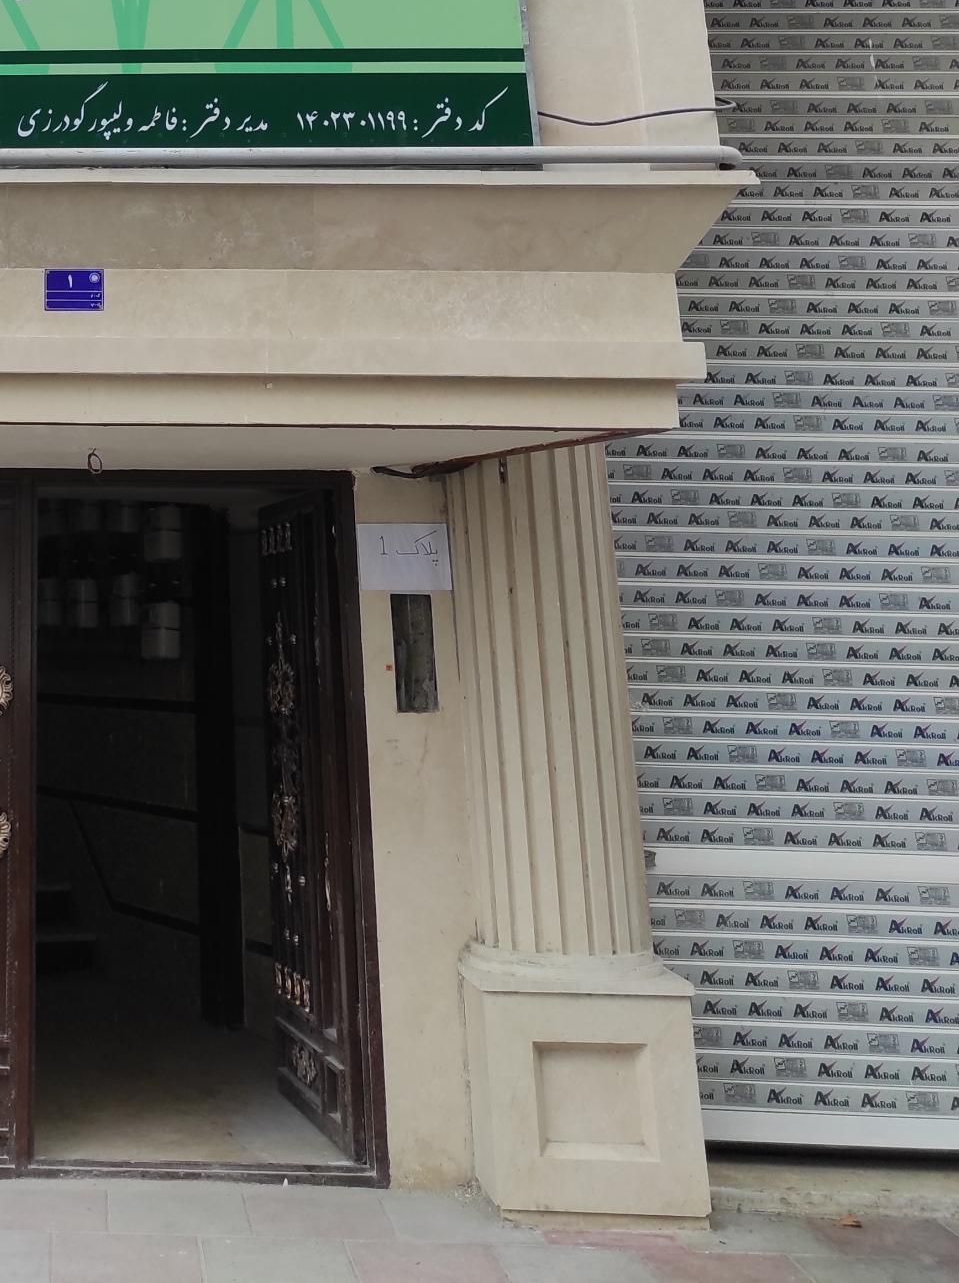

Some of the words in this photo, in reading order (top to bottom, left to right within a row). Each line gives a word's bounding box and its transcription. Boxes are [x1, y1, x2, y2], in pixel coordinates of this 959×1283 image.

[16, 80, 109, 138] گودرزی
[137, 104, 178, 132] فاطمه
[467, 85, 509, 133] کد
[235, 114, 269, 134] مدیر
[718, 256, 750, 270] AkRoll
[758, 256, 790, 270] AkRoll
[798, 256, 830, 270] AkRoll
[876, 257, 908, 271] AkRoll
[916, 258, 948, 272] AkRoll
[716, 344, 748, 358] AkRoll
[756, 344, 788, 358] AkRoll
[834, 346, 866, 360] AkRoll
[874, 346, 906, 360] AkRoll
[916, 347, 948, 361] AkRoll
[636, 443, 666, 458] AkRoll
[678, 444, 707, 459] AkRoll
[755, 445, 786, 461] AkRoll
[796, 446, 828, 462] AkRoll
[838, 446, 869, 462] AkRoll
[916, 448, 948, 464] AkRoll
[395, 529, 439, 567] پلاک
[684, 537, 714, 553] AkRoll
[725, 538, 756, 554] AkRoll
[766, 539, 798, 555] AkRoll
[846, 540, 876, 556] AkRoll
[888, 542, 918, 558] AkRoll
[680, 641, 712, 657] AkRoll
[722, 642, 755, 658] AkRoll
[765, 642, 798, 659] AkRoll
[846, 644, 878, 661] AkRoll
[888, 645, 921, 662] AkRoll
[644, 744, 676, 760] AkRoll
[686, 745, 718, 762] AkRoll
[768, 748, 800, 764] AkRoll
[810, 748, 843, 765] AkRoll
[854, 750, 886, 766] AkRoll
[656, 826, 689, 842] AkRoll
[700, 828, 733, 844] AkRoll
[784, 830, 816, 846] AkRoll
[828, 830, 862, 848] AkRoll
[872, 832, 906, 850] AkRoll
[656, 880, 690, 898] AkRoll
[700, 881, 734, 898] AkRoll
[784, 884, 818, 901] AkRoll
[830, 885, 864, 902] AkRoll
[875, 886, 909, 904] AkRoll
[715, 912, 749, 930] AkRoll
[760, 914, 794, 931] AkRoll
[804, 915, 838, 932] AkRoll
[888, 918, 922, 936] AkRoll
[690, 940, 724, 958] AkRoll
[774, 944, 808, 961] AkRoll
[819, 945, 853, 962] AkRoll
[864, 947, 898, 964] AkRoll
[700, 969, 734, 986] AkRoll
[744, 971, 778, 988] AkRoll
[830, 974, 864, 992] AkRoll
[875, 976, 909, 993] AkRoll
[920, 977, 956, 995] AkRoll
[702, 999, 736, 1016] AkRoll
[748, 1000, 782, 1018] AkRoll
[793, 1002, 827, 1020] AkRoll
[879, 1006, 913, 1023] AkRoll
[732, 1030, 766, 1048] AkRoll
[778, 1032, 812, 1050] AkRoll
[824, 1034, 858, 1051] AkRoll
[910, 1037, 946, 1055] AkRoll
[730, 1058, 765, 1076] AkRoll
[817, 1061, 852, 1079] AkRoll
[864, 1063, 900, 1081] AkRoll
[911, 1064, 946, 1082] AkRoll
[766, 1088, 802, 1106] AkRoll
[814, 1090, 849, 1108] AkRoll
[860, 1092, 896, 1110] AkRoll
